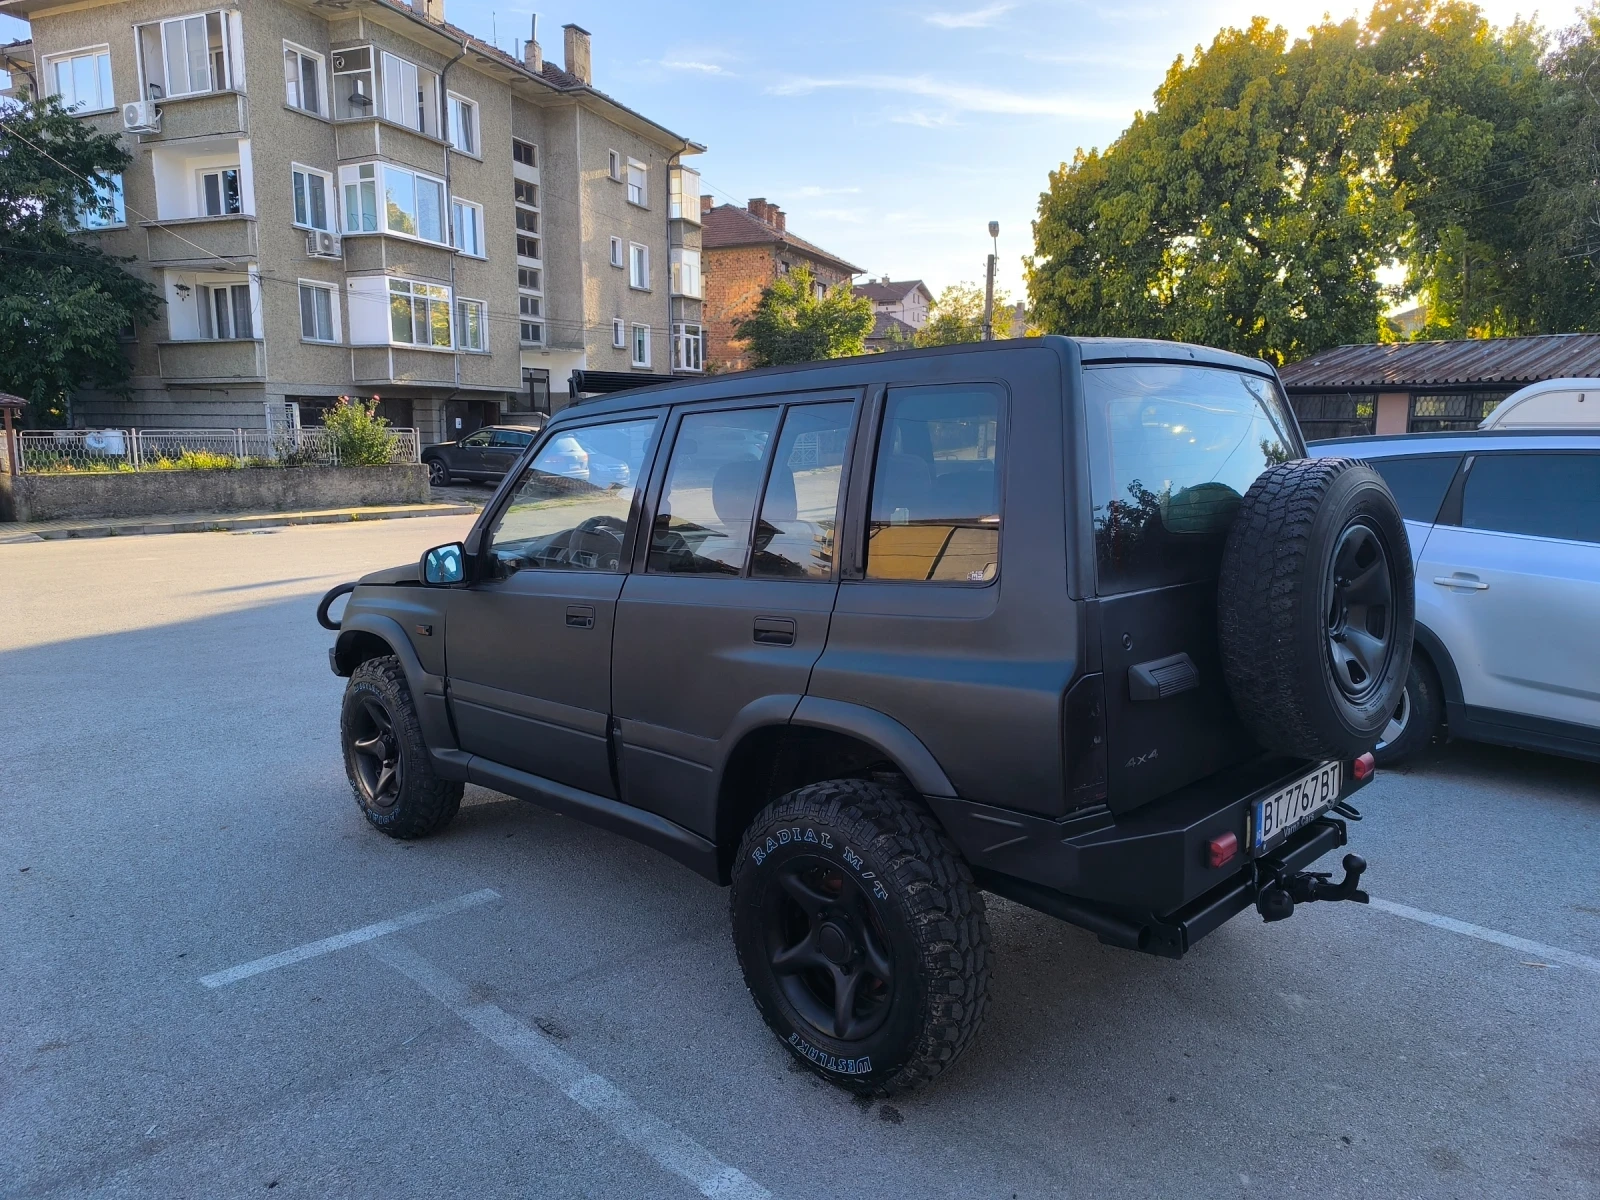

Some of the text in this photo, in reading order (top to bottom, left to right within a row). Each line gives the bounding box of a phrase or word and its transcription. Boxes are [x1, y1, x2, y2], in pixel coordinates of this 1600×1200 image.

[752, 827, 889, 901] RADIAL M/T
[788, 1031, 873, 1074] WESTLAKE
